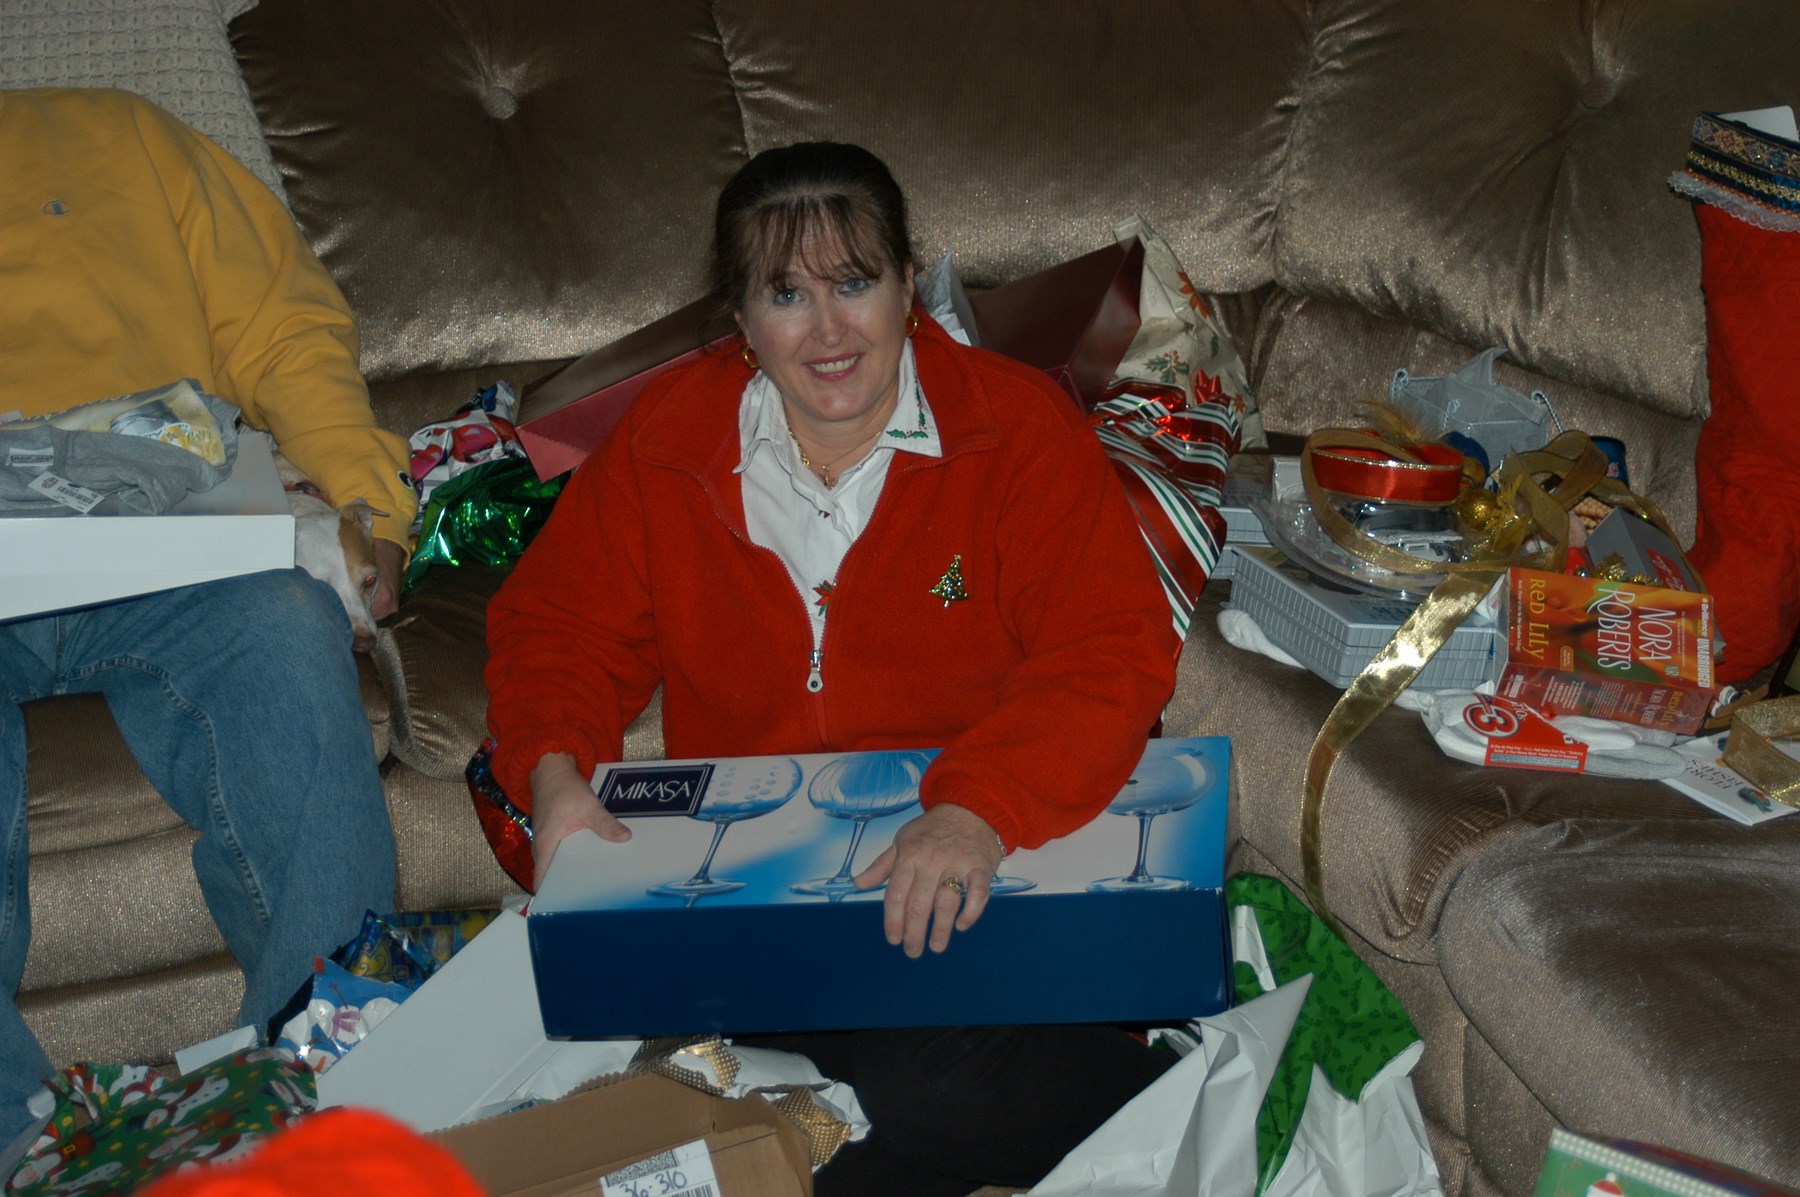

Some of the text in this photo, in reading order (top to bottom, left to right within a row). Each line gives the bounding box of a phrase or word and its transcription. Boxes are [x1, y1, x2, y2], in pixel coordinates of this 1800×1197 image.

[1586, 588, 1636, 670] ROBERTS
[1637, 606, 1678, 661] NORA
[1697, 637, 1711, 688] UNABRIDGED
[612, 780, 691, 803] MIKASA
